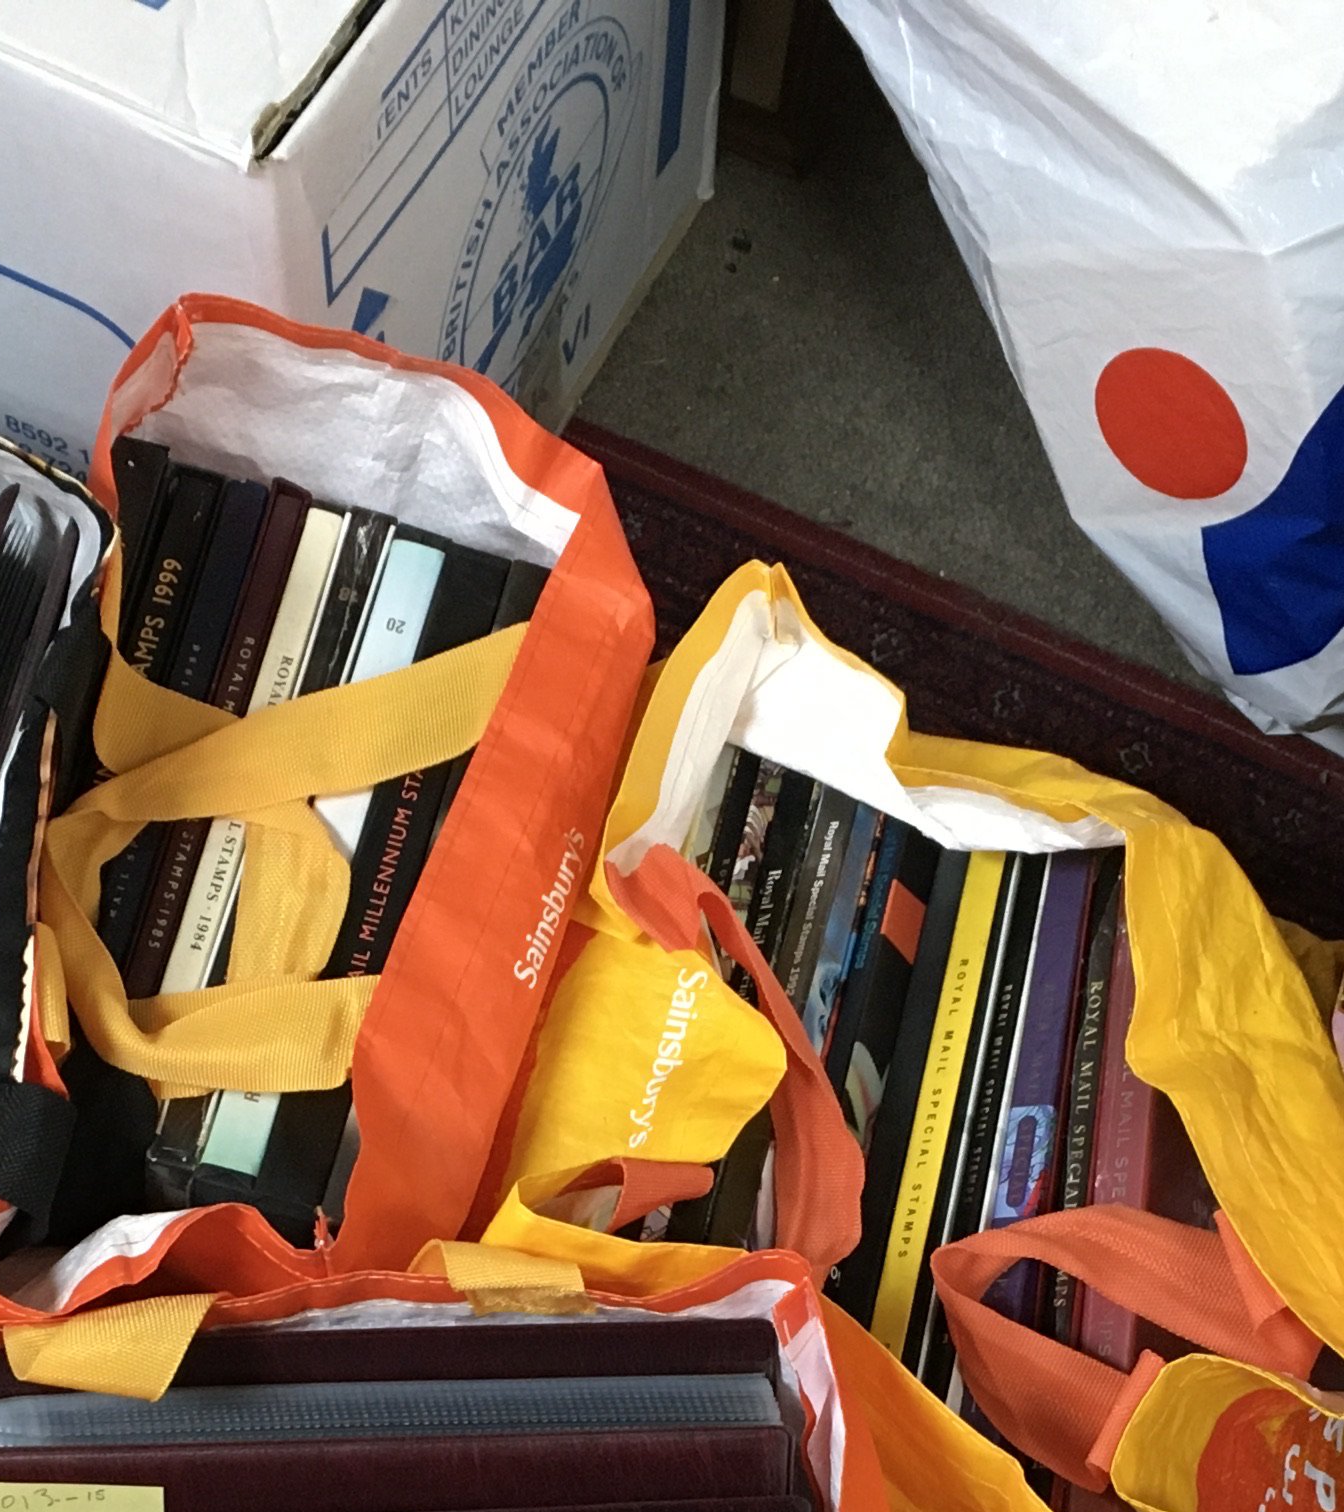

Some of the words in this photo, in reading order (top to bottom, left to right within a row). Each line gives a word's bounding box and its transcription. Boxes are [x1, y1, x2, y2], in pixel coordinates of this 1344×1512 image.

[455, 7, 525, 115] LOUNGE
[498, 3, 581, 138] MEMBER
[442, 199, 494, 361] BRITISH
[496, 31, 618, 189] ASSOCIATION
[493, 163, 581, 333] BAR
[6, 413, 69, 452] 8592
[152, 558, 183, 607] 1999
[386, 616, 407, 635] 20
[227, 636, 257, 693] ROYAL
[816, 853, 832, 877] Mail
[823, 820, 840, 851] Royal
[206, 835, 238, 904] STAMPS
[359, 807, 414, 942] MILLENNIUM
[760, 869, 783, 911] Royal
[513, 827, 586, 989] Sainsbury's
[807, 879, 825, 920] Special
[190, 914, 213, 952] 1984
[796, 918, 814, 965] Stamps
[948, 958, 970, 1017] ROYAL
[1082, 980, 1105, 1051] ROYAL
[629, 968, 709, 1149] Sainsbury's
[936, 1030, 955, 1074] MAIL
[1075, 1060, 1096, 1115] MAIL
[916, 1088, 943, 1169] SPECIAL
[1114, 1090, 1135, 1149] MAIL
[897, 1183, 923, 1259] STAMPS
